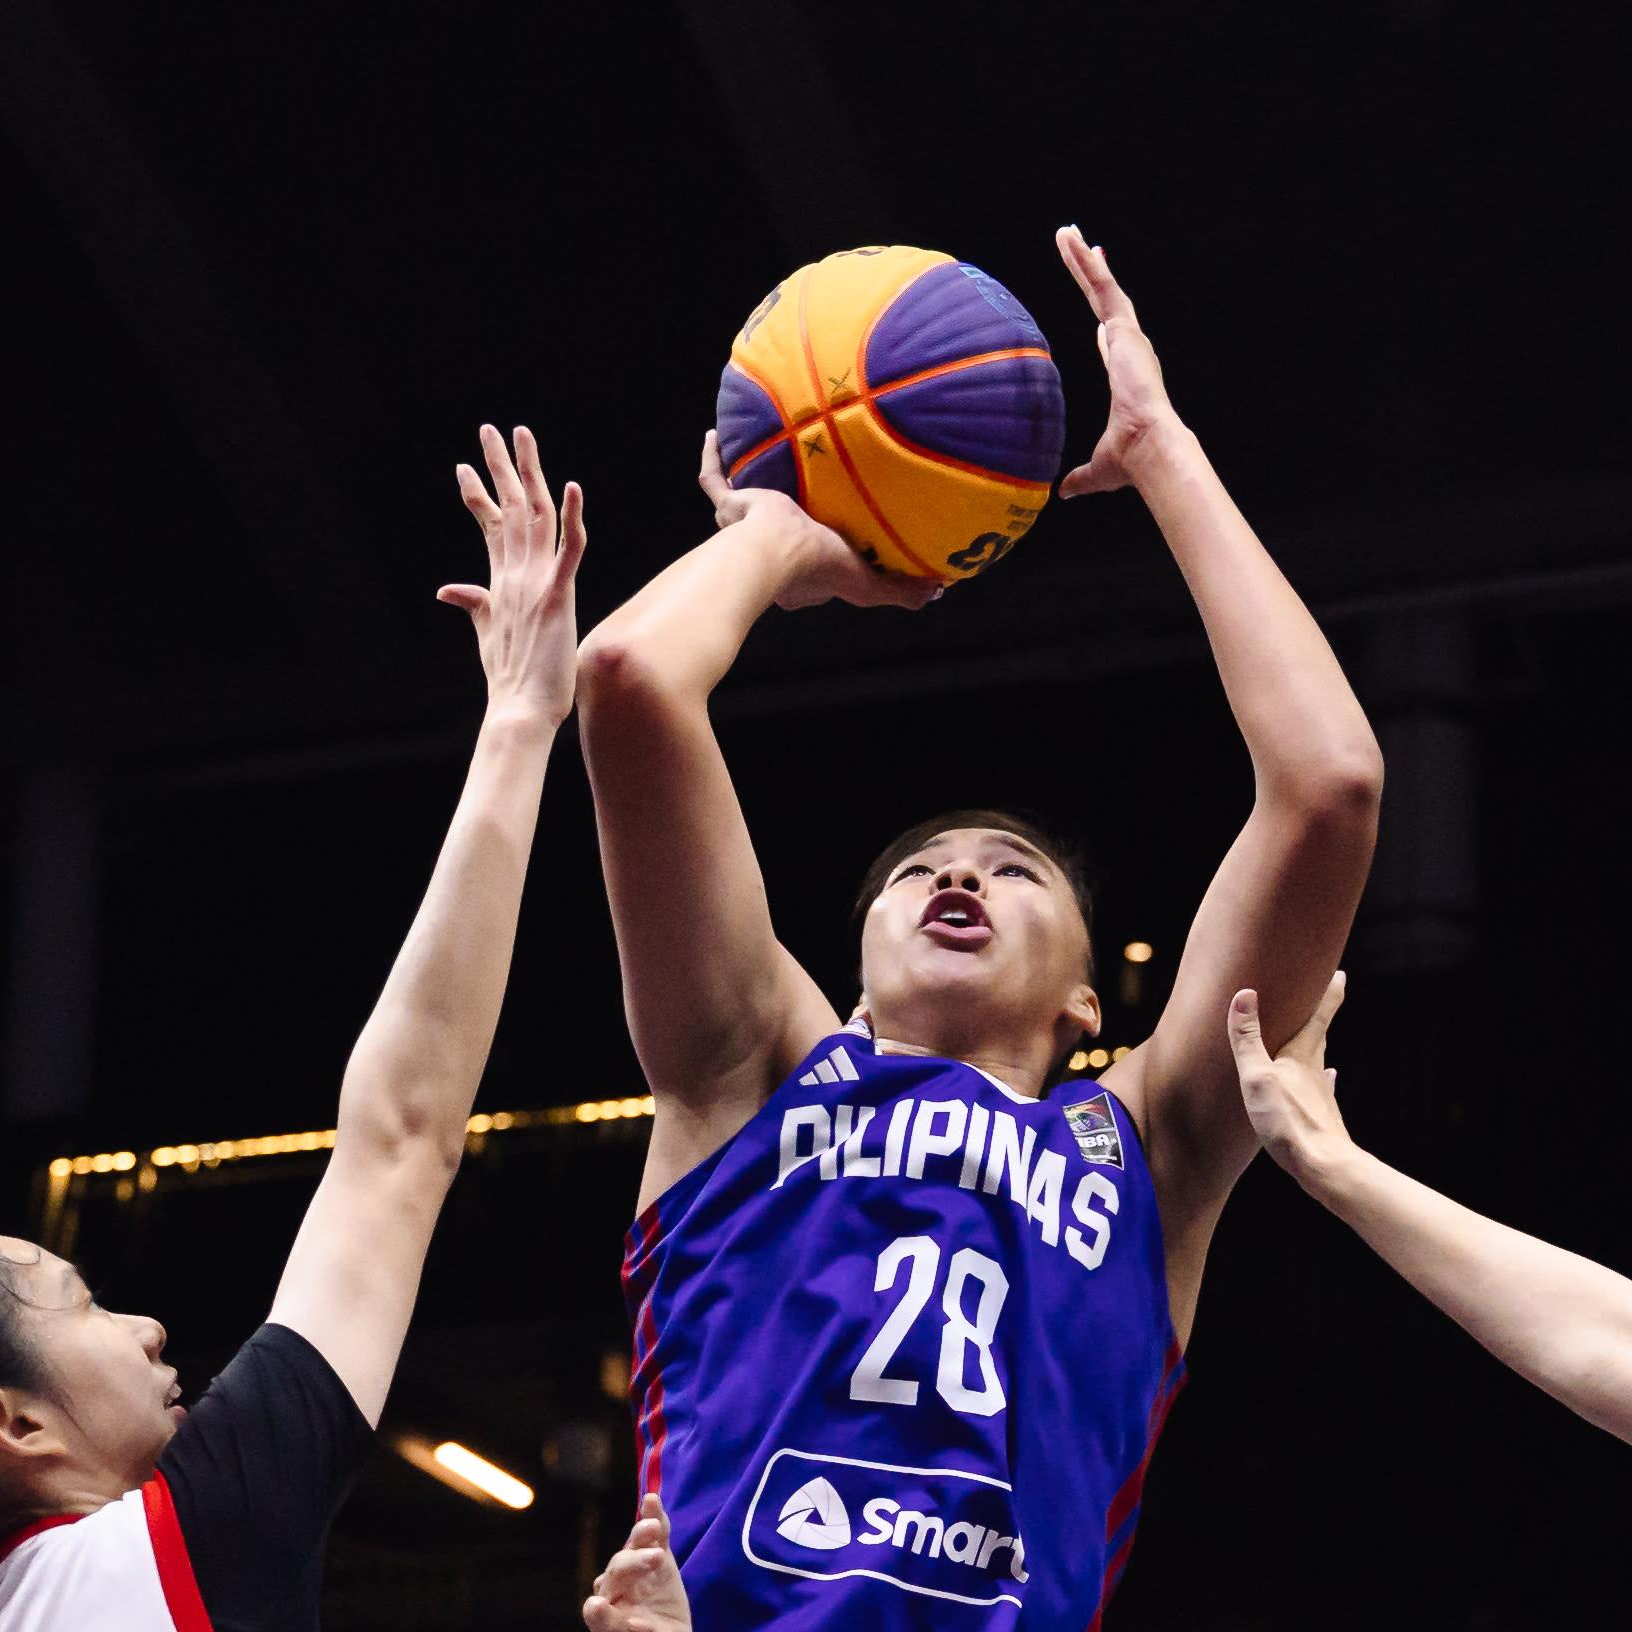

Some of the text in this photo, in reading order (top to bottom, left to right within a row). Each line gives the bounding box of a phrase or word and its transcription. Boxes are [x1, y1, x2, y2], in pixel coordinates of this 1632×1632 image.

[769, 1099, 1119, 1270] PILIPINAS
[1076, 1133, 1111, 1149] IBA
[849, 1236, 1009, 1417] 28
[857, 1498, 1029, 1583] Smart
